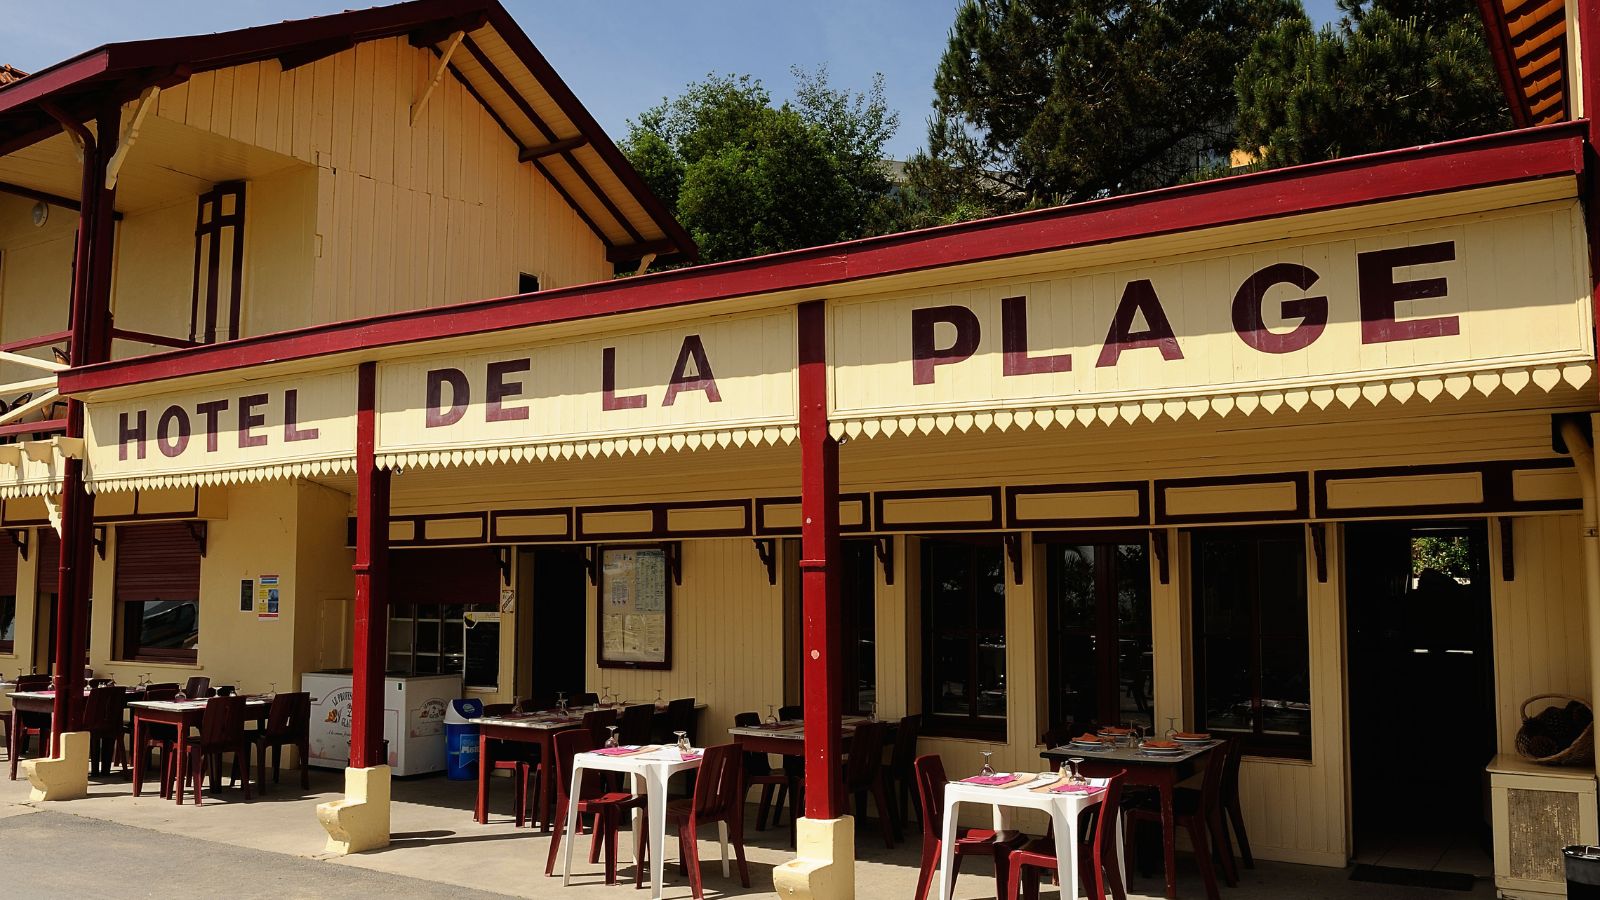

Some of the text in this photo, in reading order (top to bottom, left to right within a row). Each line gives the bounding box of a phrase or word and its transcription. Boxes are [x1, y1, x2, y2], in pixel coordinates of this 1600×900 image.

[118, 240, 1461, 461] HOTEL DE LA PLAGE
